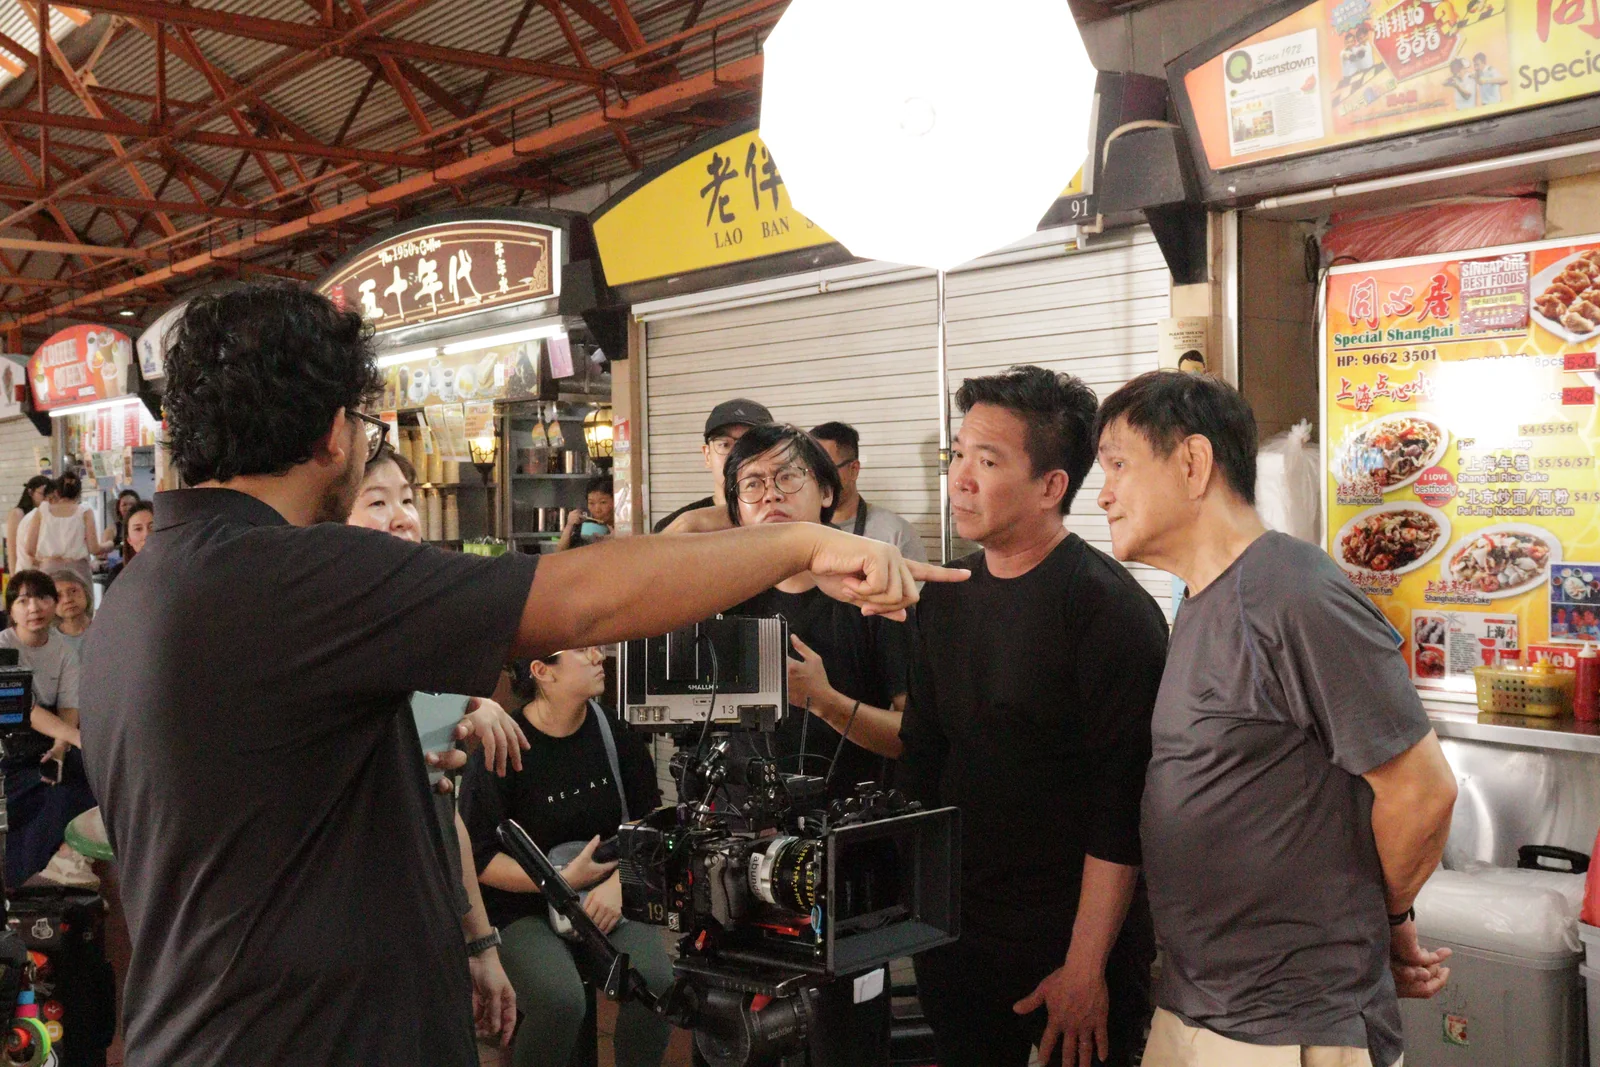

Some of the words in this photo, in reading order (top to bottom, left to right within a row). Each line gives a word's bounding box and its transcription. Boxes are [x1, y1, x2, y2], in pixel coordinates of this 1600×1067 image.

[1225, 50, 1316, 84] Queenstown
[1071, 198, 1089, 219] 91
[714, 227, 744, 249] LAO
[761, 216, 791, 239] BAN
[358, 248, 483, 320] 五十年代
[1463, 275, 1489, 290] BEST
[1491, 271, 1525, 287] FOODS
[1348, 273, 1453, 330] 同心居
[1334, 330, 1383, 347] Special
[1387, 324, 1454, 341] Shanghai
[1337, 355, 1359, 367] HP:
[1362, 352, 1398, 365] 9662
[1402, 349, 1437, 362] 3501
[1336, 371, 1437, 412] 上海点心小
[1466, 455, 1530, 472] 上海年糕
[1538, 457, 1590, 468] $5/$6/$7
[1429, 473, 1448, 481] LOVE
[1457, 473, 1499, 484] Shanghai
[1501, 473, 1521, 483] Rice
[1523, 472, 1549, 482] Cake
[1495, 506, 1528, 516] Noodle
[1535, 506, 1554, 516] Hor
[1555, 506, 1575, 516] Fun
[1424, 594, 1455, 605] Shanghai
[1473, 596, 1491, 604] Cake
[721, 704, 735, 714] 13
[647, 901, 664, 921] 19
